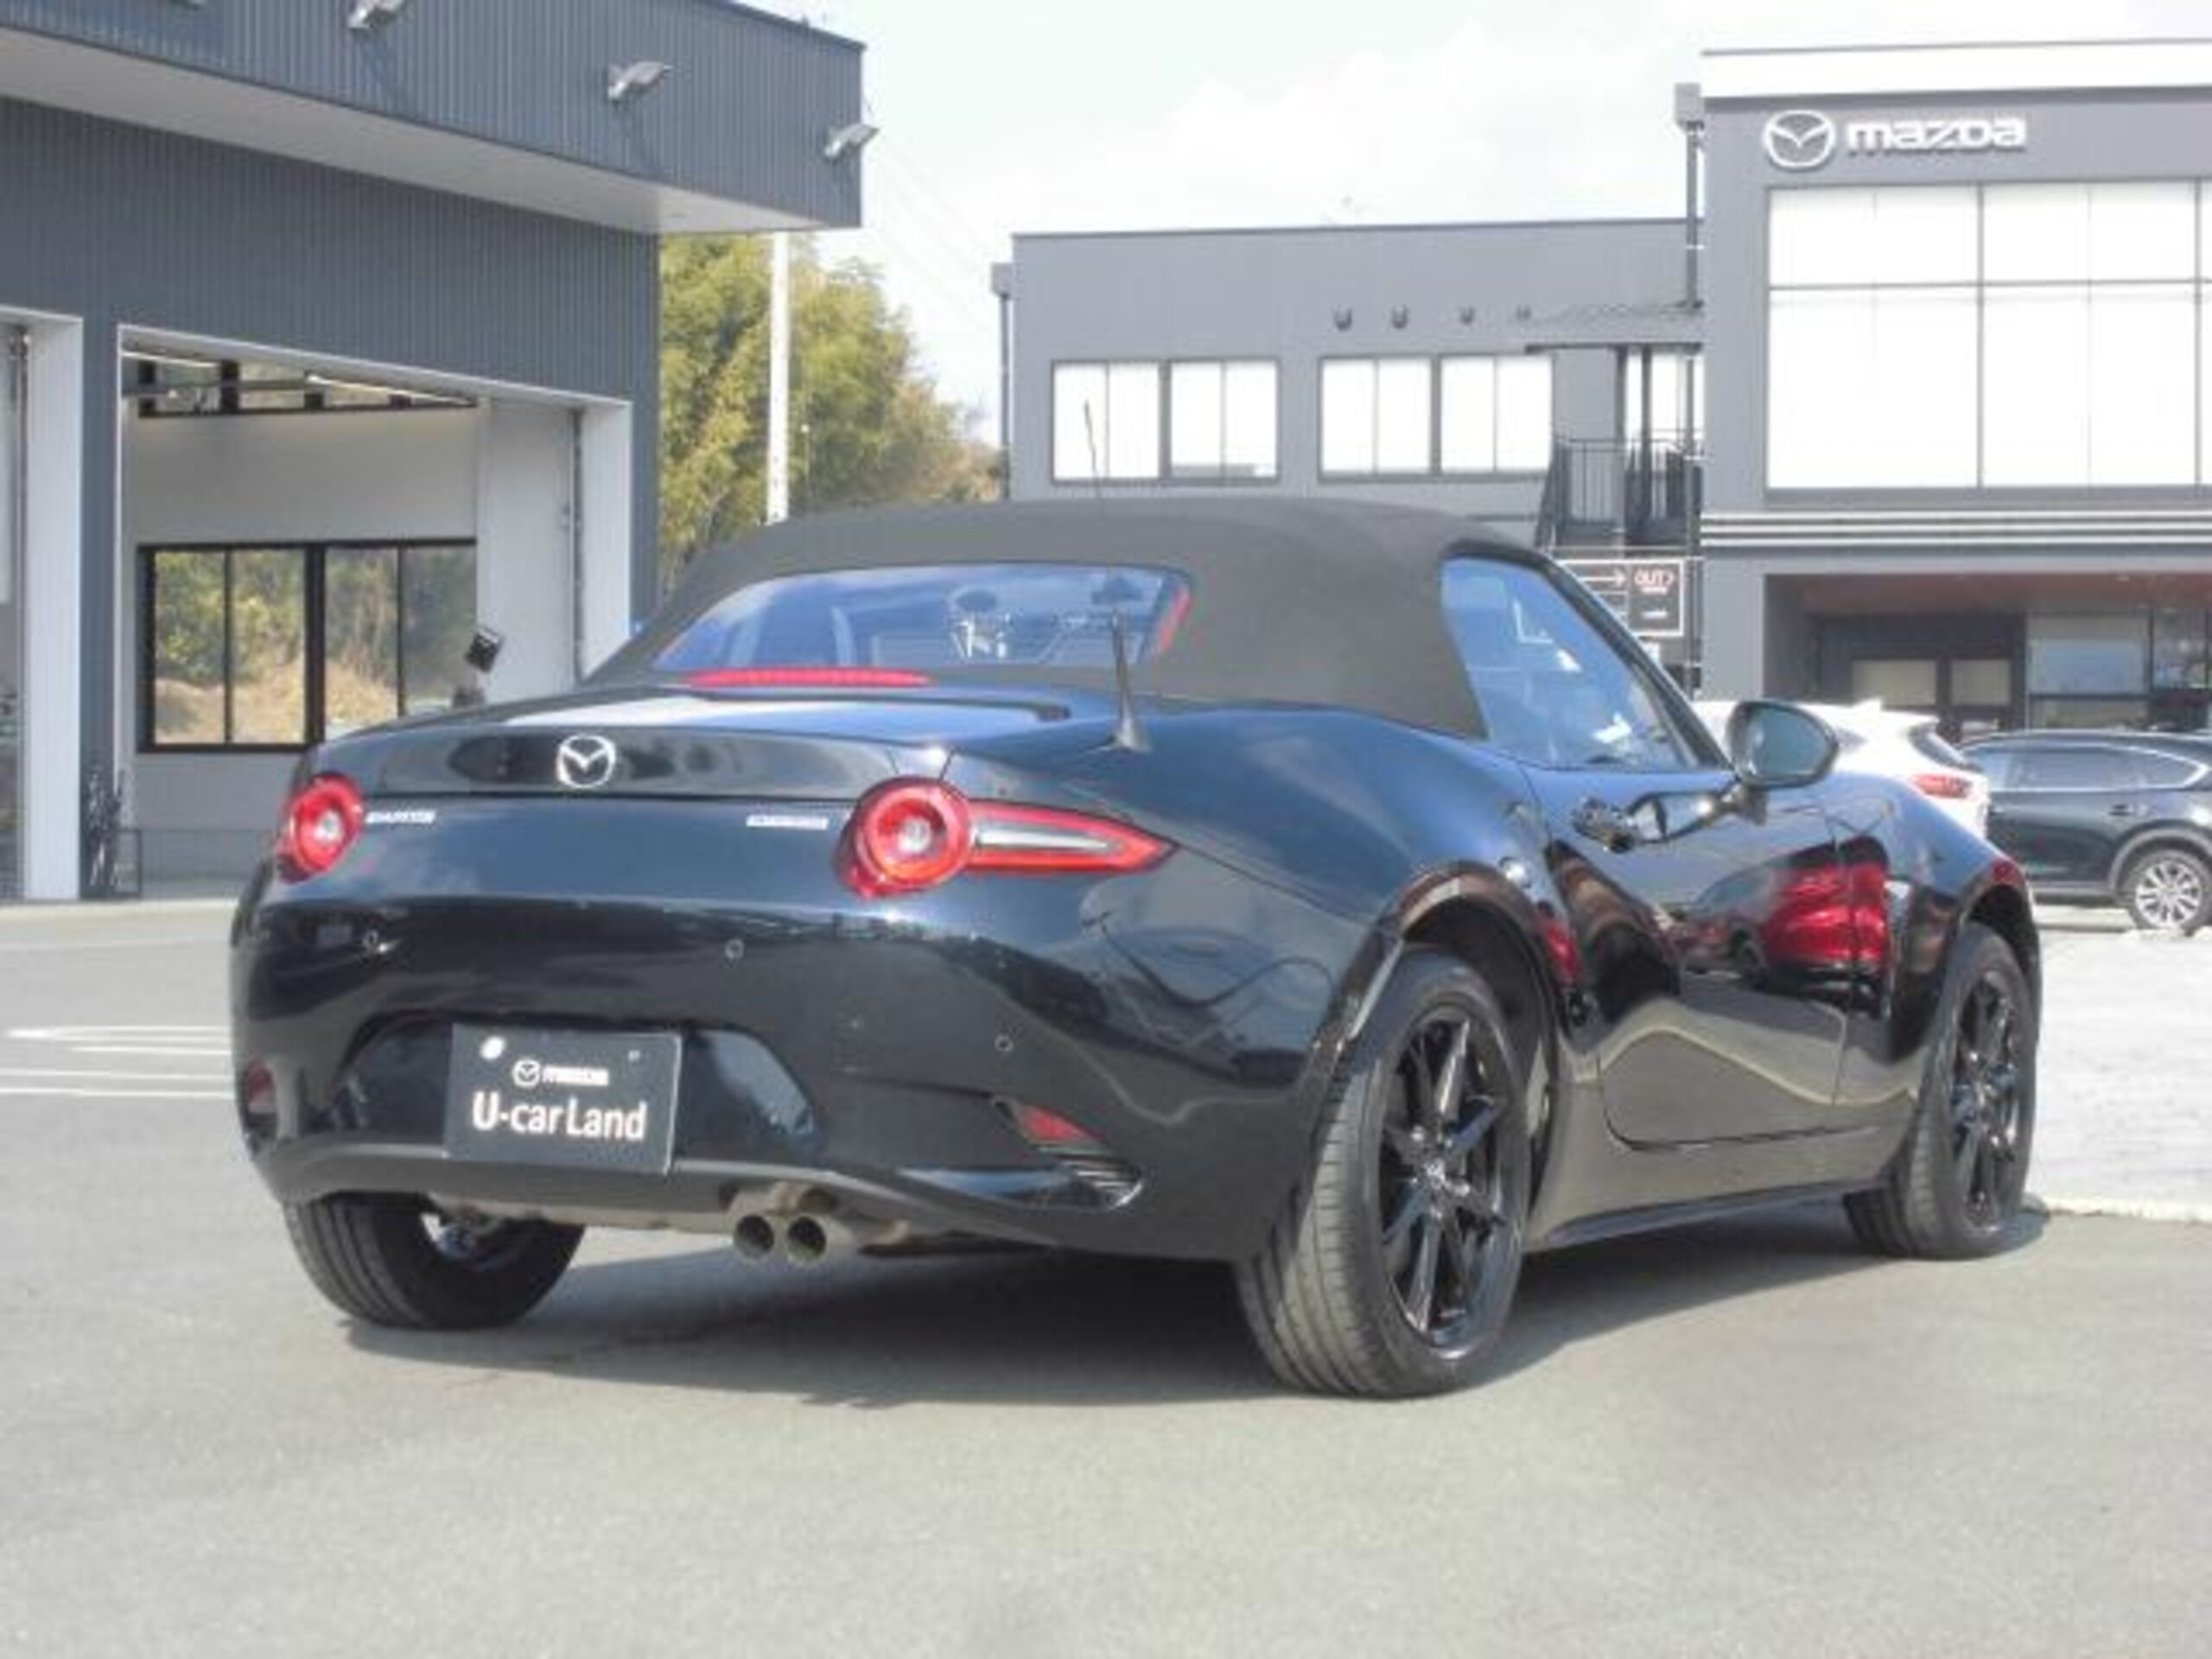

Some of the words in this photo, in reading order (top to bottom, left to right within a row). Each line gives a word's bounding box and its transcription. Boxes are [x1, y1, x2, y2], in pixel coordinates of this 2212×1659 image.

[1847, 116, 2026, 150] mazda
[1634, 569, 1664, 586] OUT
[566, 1096, 647, 1141] Land
